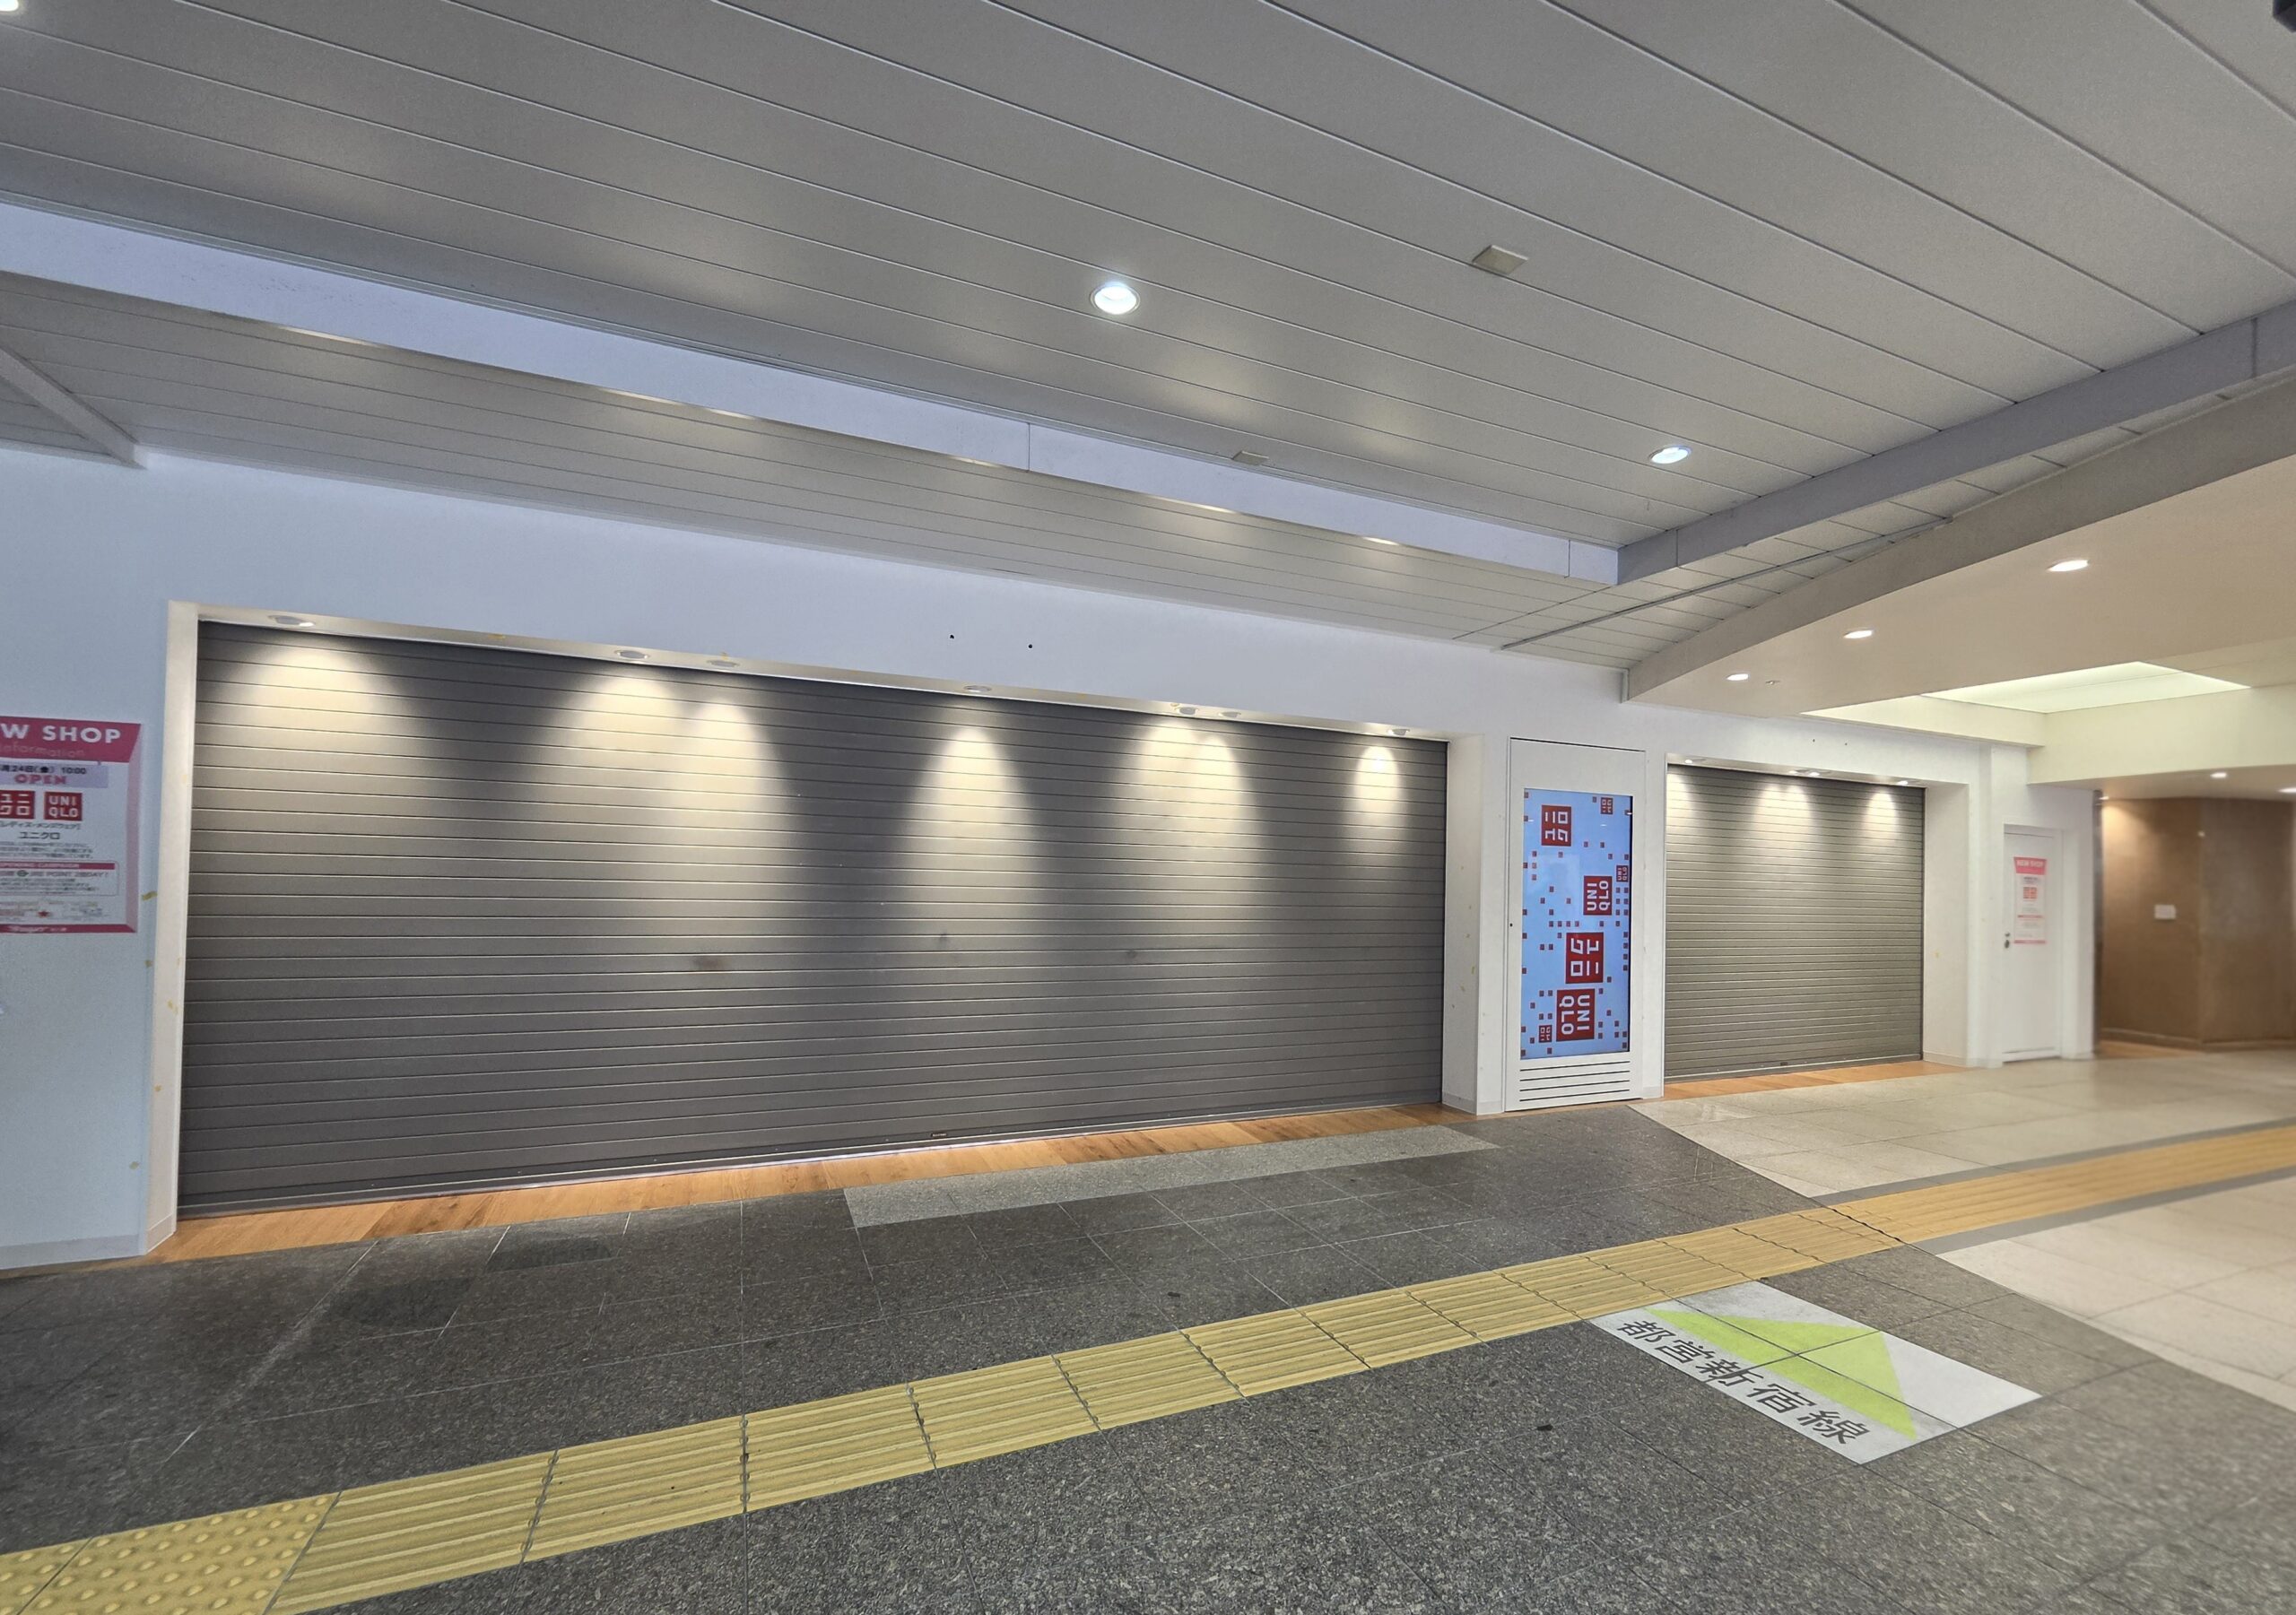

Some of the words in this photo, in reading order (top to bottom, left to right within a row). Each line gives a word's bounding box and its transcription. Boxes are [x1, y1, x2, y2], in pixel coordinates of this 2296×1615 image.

[42, 725, 121, 743] SHOP
[14, 774, 67, 785] OPEN
[62, 767, 87, 775] 10:00
[48, 795, 77, 806] UNI
[48, 807, 79, 818] QLO
[18, 831, 61, 840] ユニクロ
[1587, 882, 1597, 911] UNI
[1598, 881, 1611, 911] QLO
[1570, 937, 1584, 977] クロ
[1587, 939, 1599, 977] ユニ
[1559, 995, 1575, 1035] QLO
[1577, 994, 1590, 1031] UNI
[1617, 1320, 1870, 1445] 都営新宿線
